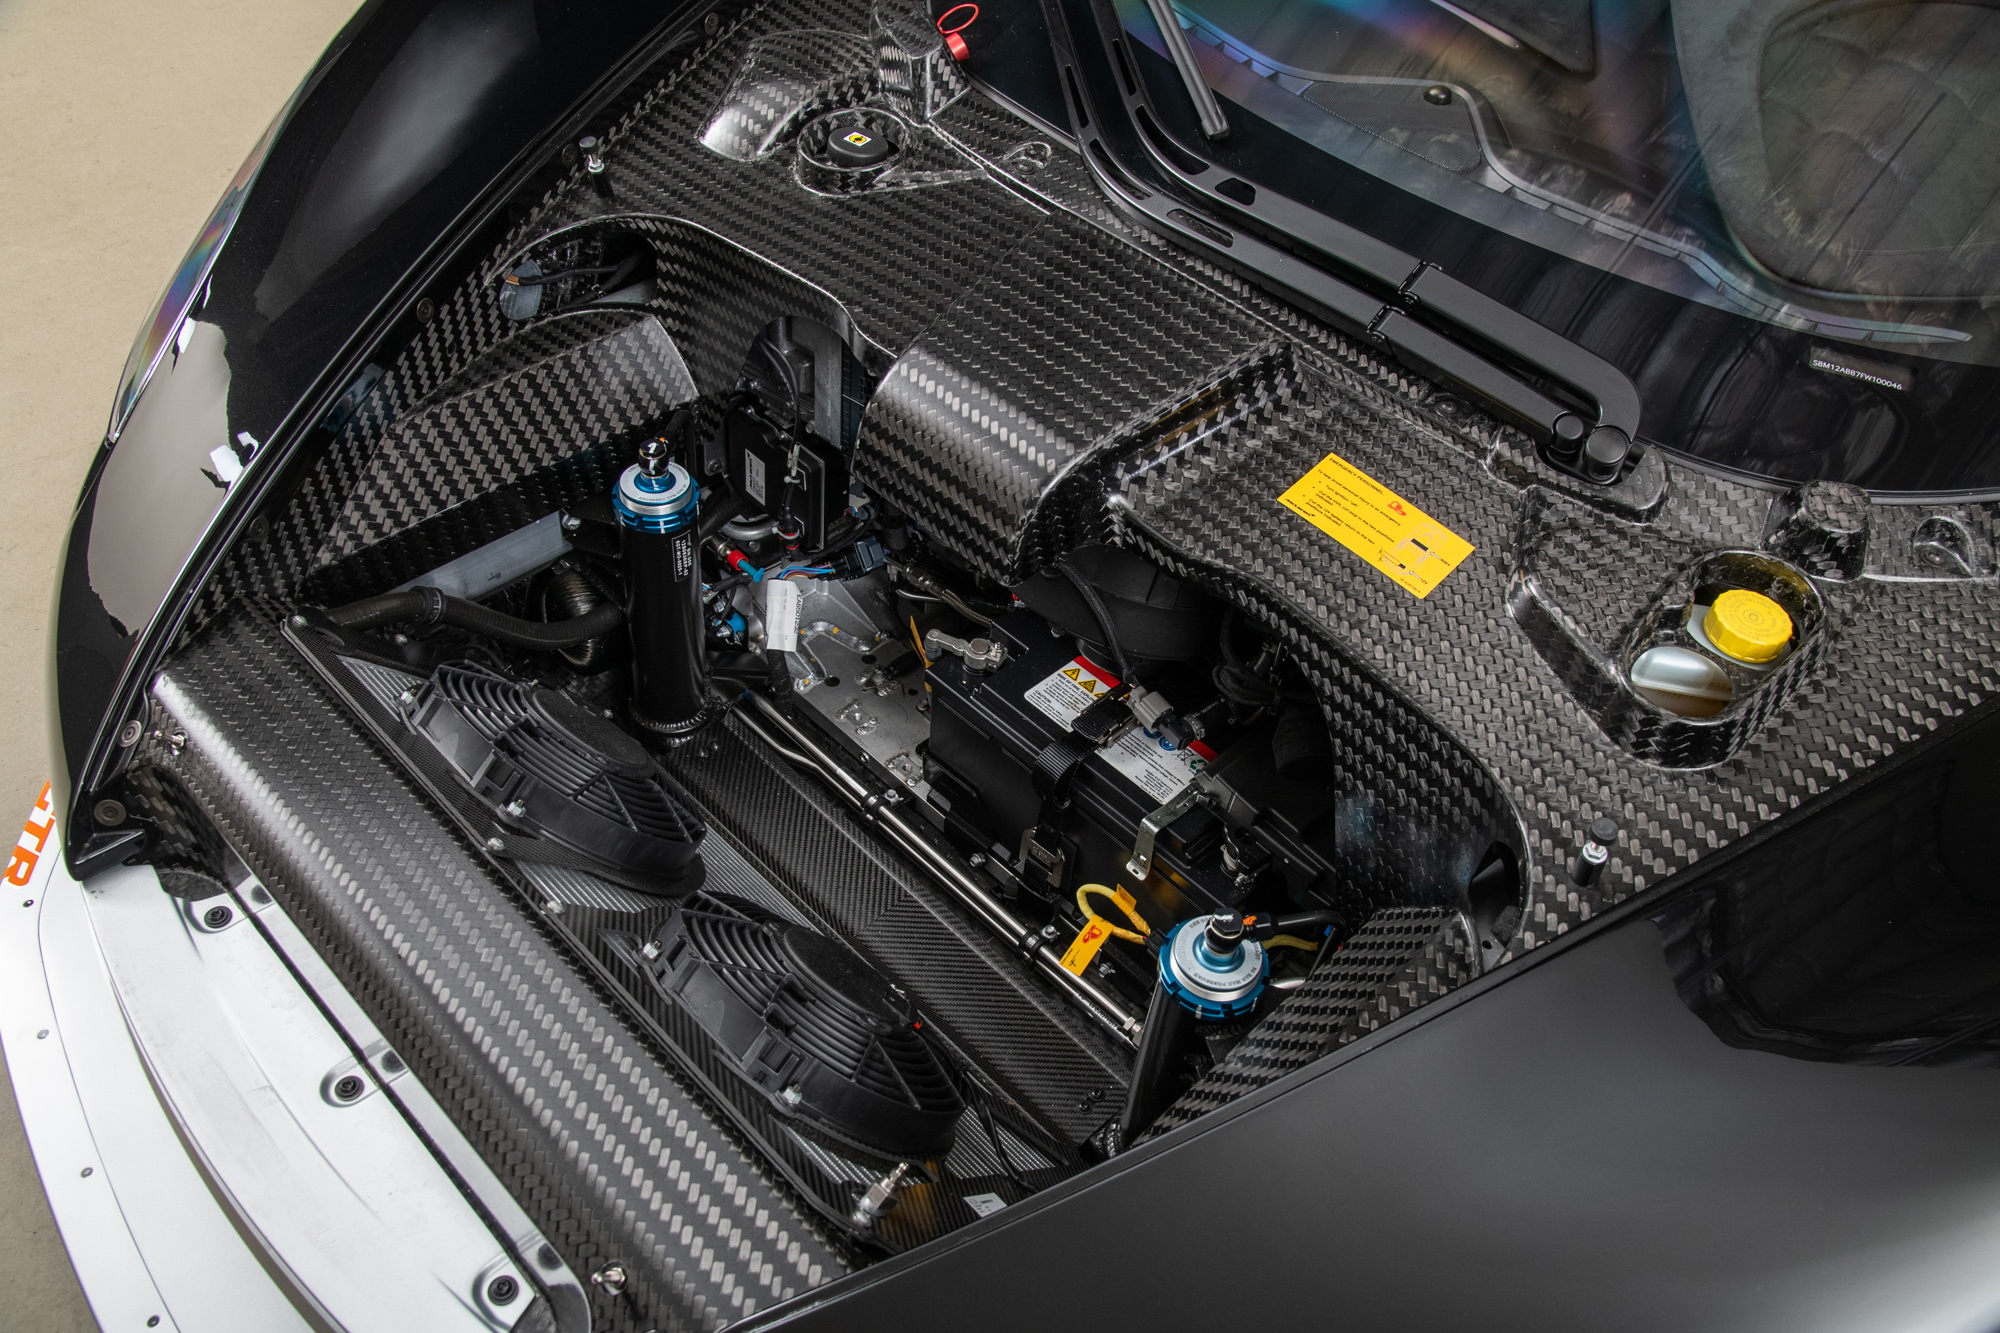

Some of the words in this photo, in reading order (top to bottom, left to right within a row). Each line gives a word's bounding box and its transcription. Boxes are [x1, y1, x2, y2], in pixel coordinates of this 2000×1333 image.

[1329, 457, 1356, 476] EMERGENCY
[1356, 475, 1383, 494] PERSONNEL
[1341, 485, 1358, 497] personal
[1379, 510, 1400, 526] emergency
